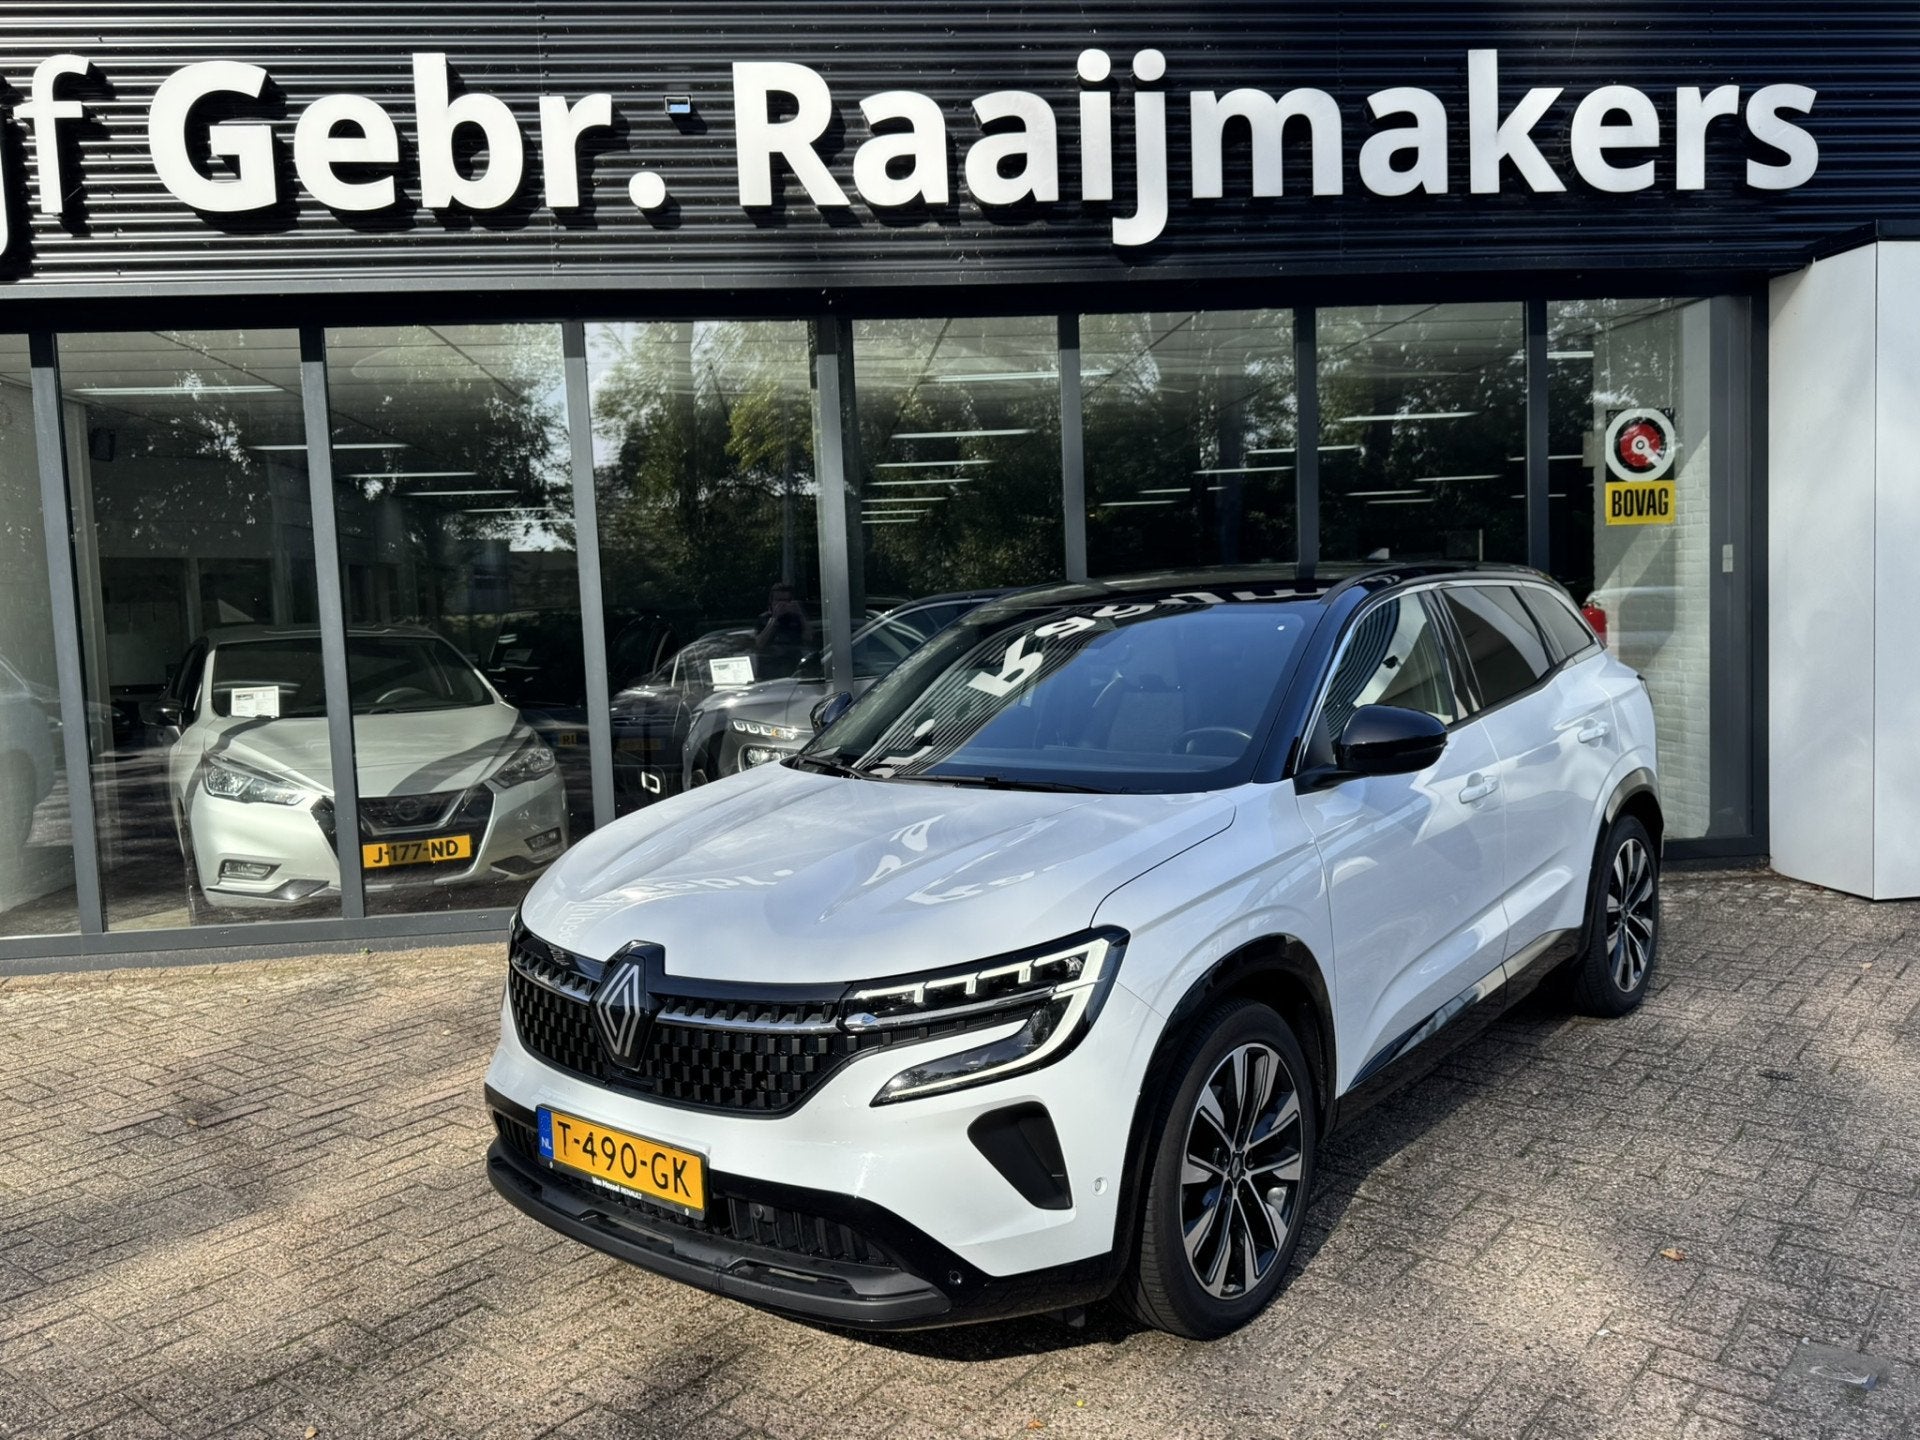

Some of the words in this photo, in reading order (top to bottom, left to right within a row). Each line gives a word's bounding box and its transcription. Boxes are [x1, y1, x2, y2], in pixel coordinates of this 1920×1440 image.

[148, 53, 666, 212] Gebr.
[732, 49, 1818, 246] Raaijmakers
[1611, 488, 1669, 517] BOVAG
[372, 839, 459, 864] J-177-ND
[541, 1136, 552, 1150] NL
[557, 1120, 691, 1198] T-490-GK
